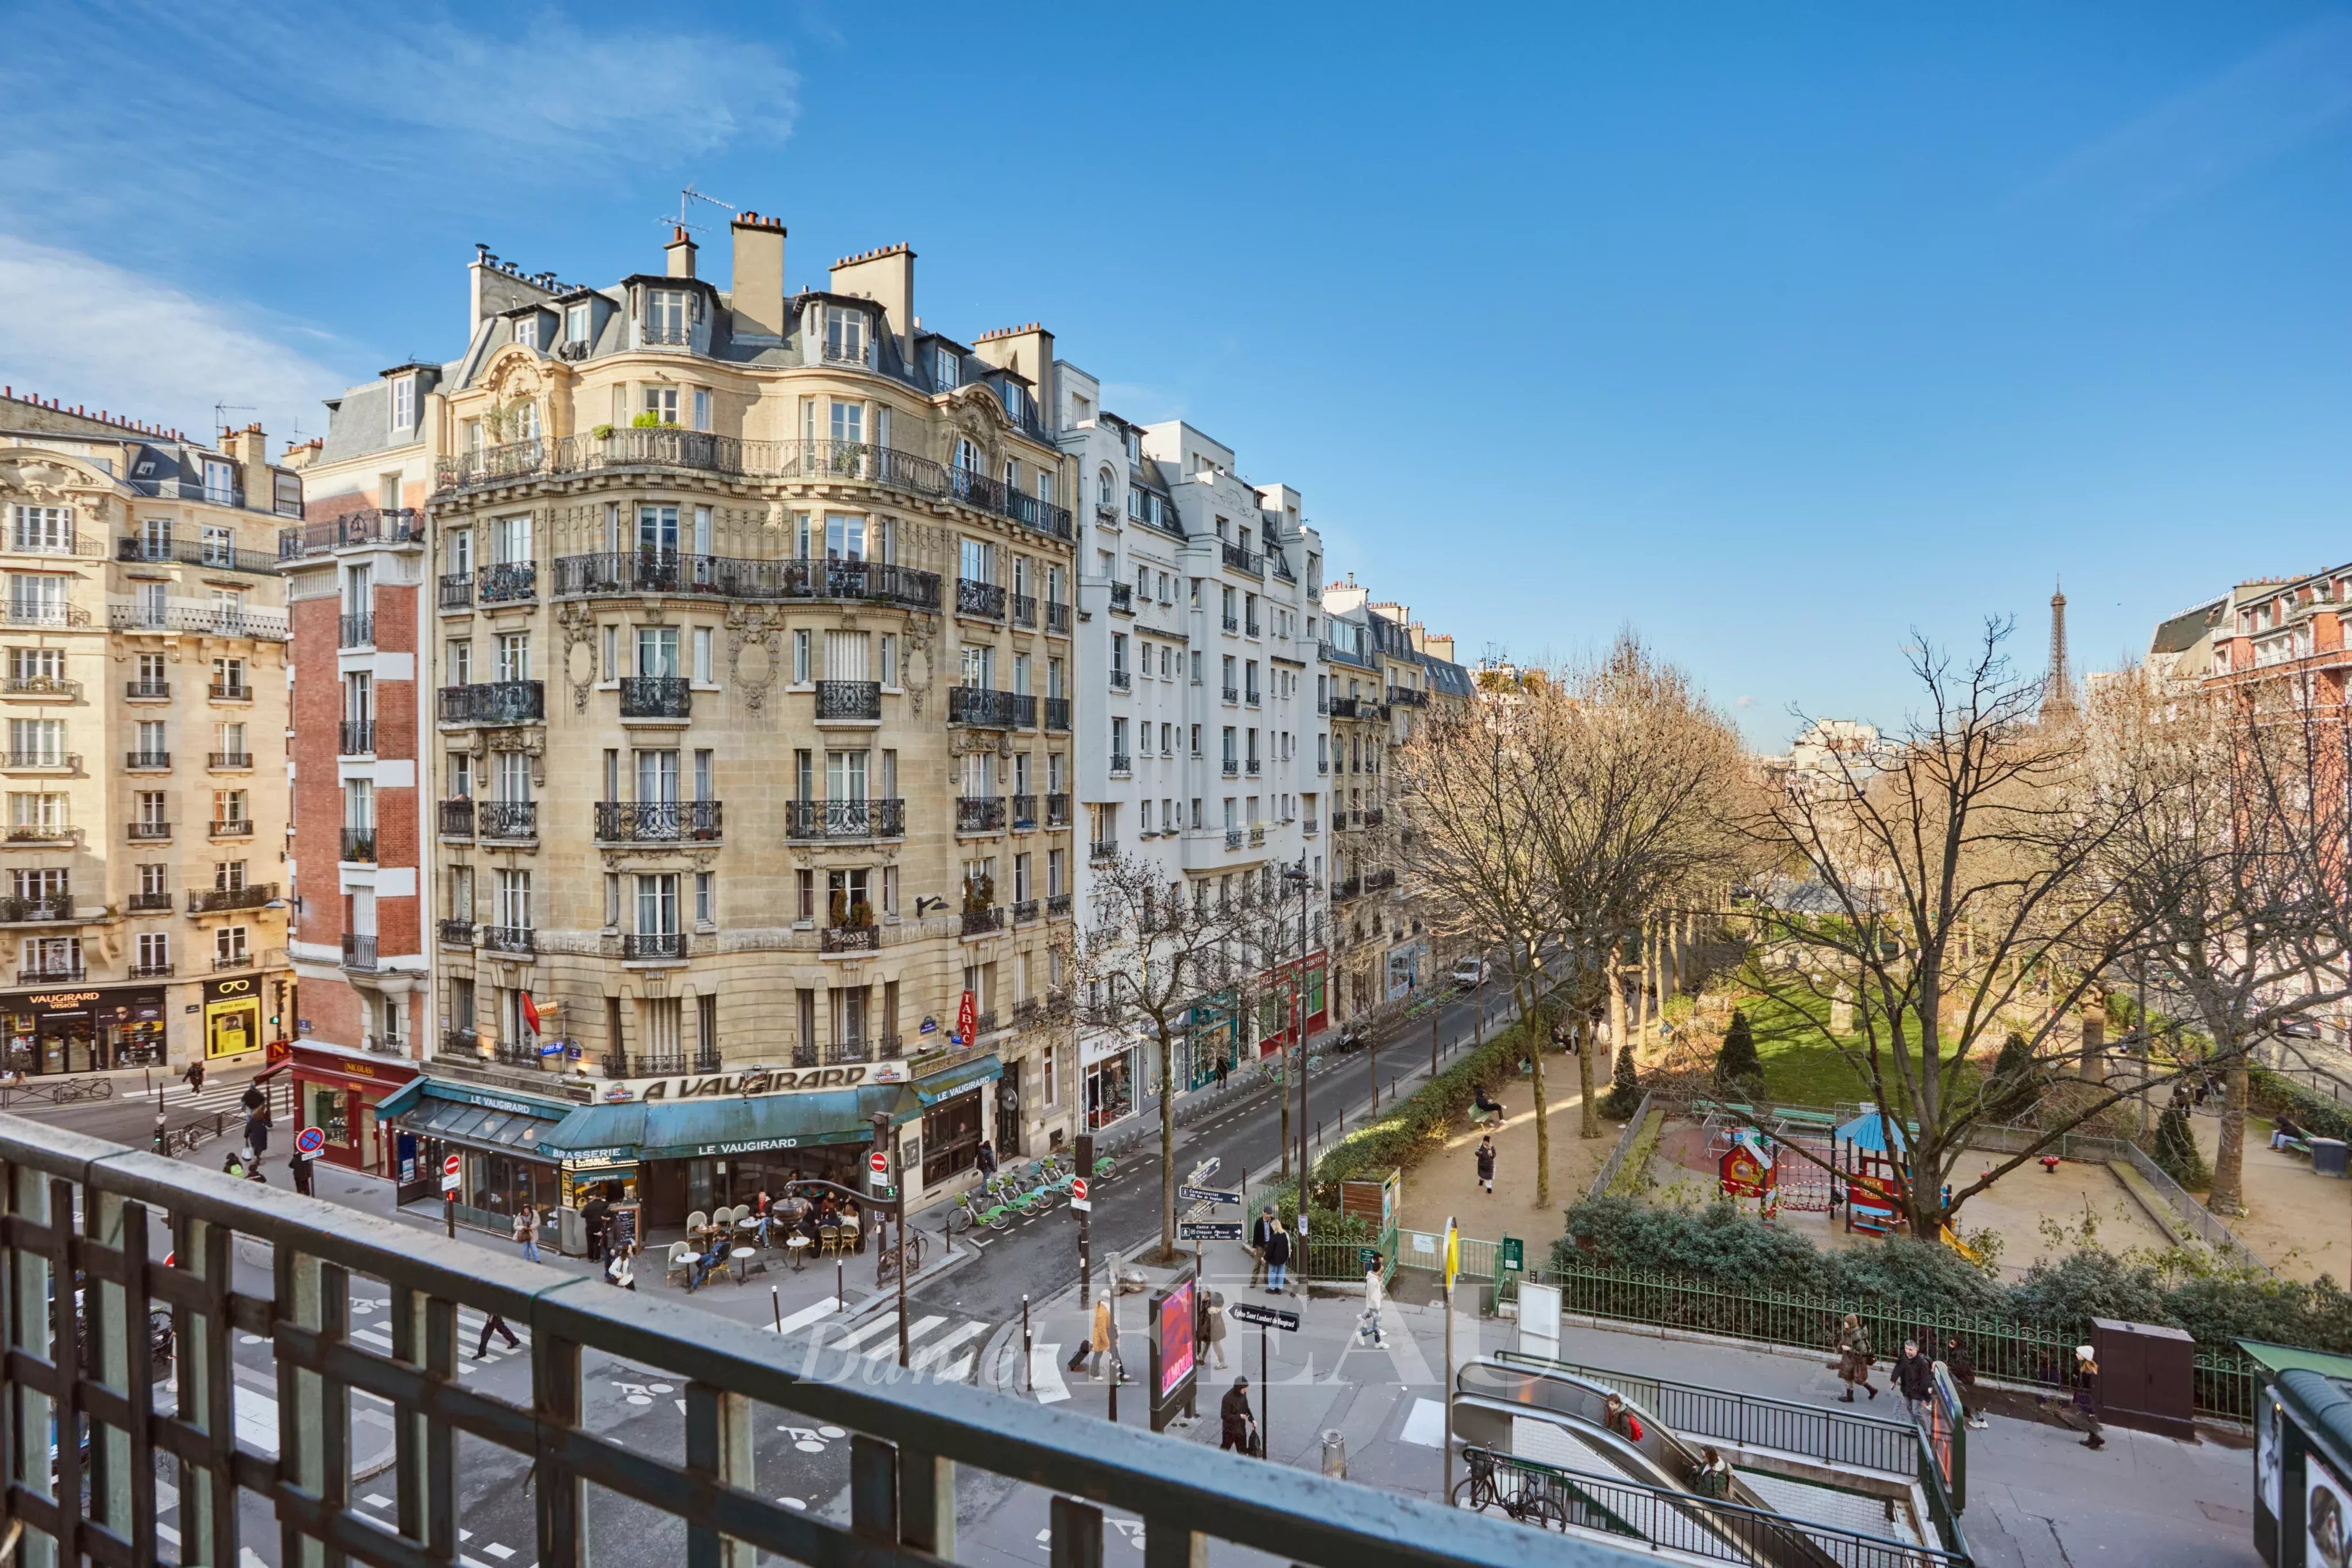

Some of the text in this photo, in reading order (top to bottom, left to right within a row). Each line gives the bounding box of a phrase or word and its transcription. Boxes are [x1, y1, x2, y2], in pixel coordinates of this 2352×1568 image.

[29, 992, 99, 1004] VAUGIRARD
[539, 1006, 556, 1015] Tabac
[961, 994, 972, 1043] TABAC
[273, 1044, 284, 1056] N
[346, 1063, 373, 1074] NICOLAS
[915, 1055, 962, 1077] BRASSERIE
[643, 1081, 667, 1100] A
[937, 1075, 990, 1102] LE VAUGIRARD
[471, 1095, 530, 1113] LE VAUGIRARD
[552, 1148, 621, 1160] BRASSERIE
[699, 1139, 797, 1155] LE VAUGIRARD
[1189, 1189, 1219, 1197] Commissariat
[1247, 1311, 1256, 1320] Saint
[1256, 1313, 1272, 1323] Lambert
[1278, 1318, 1295, 1327] Vaugirard
